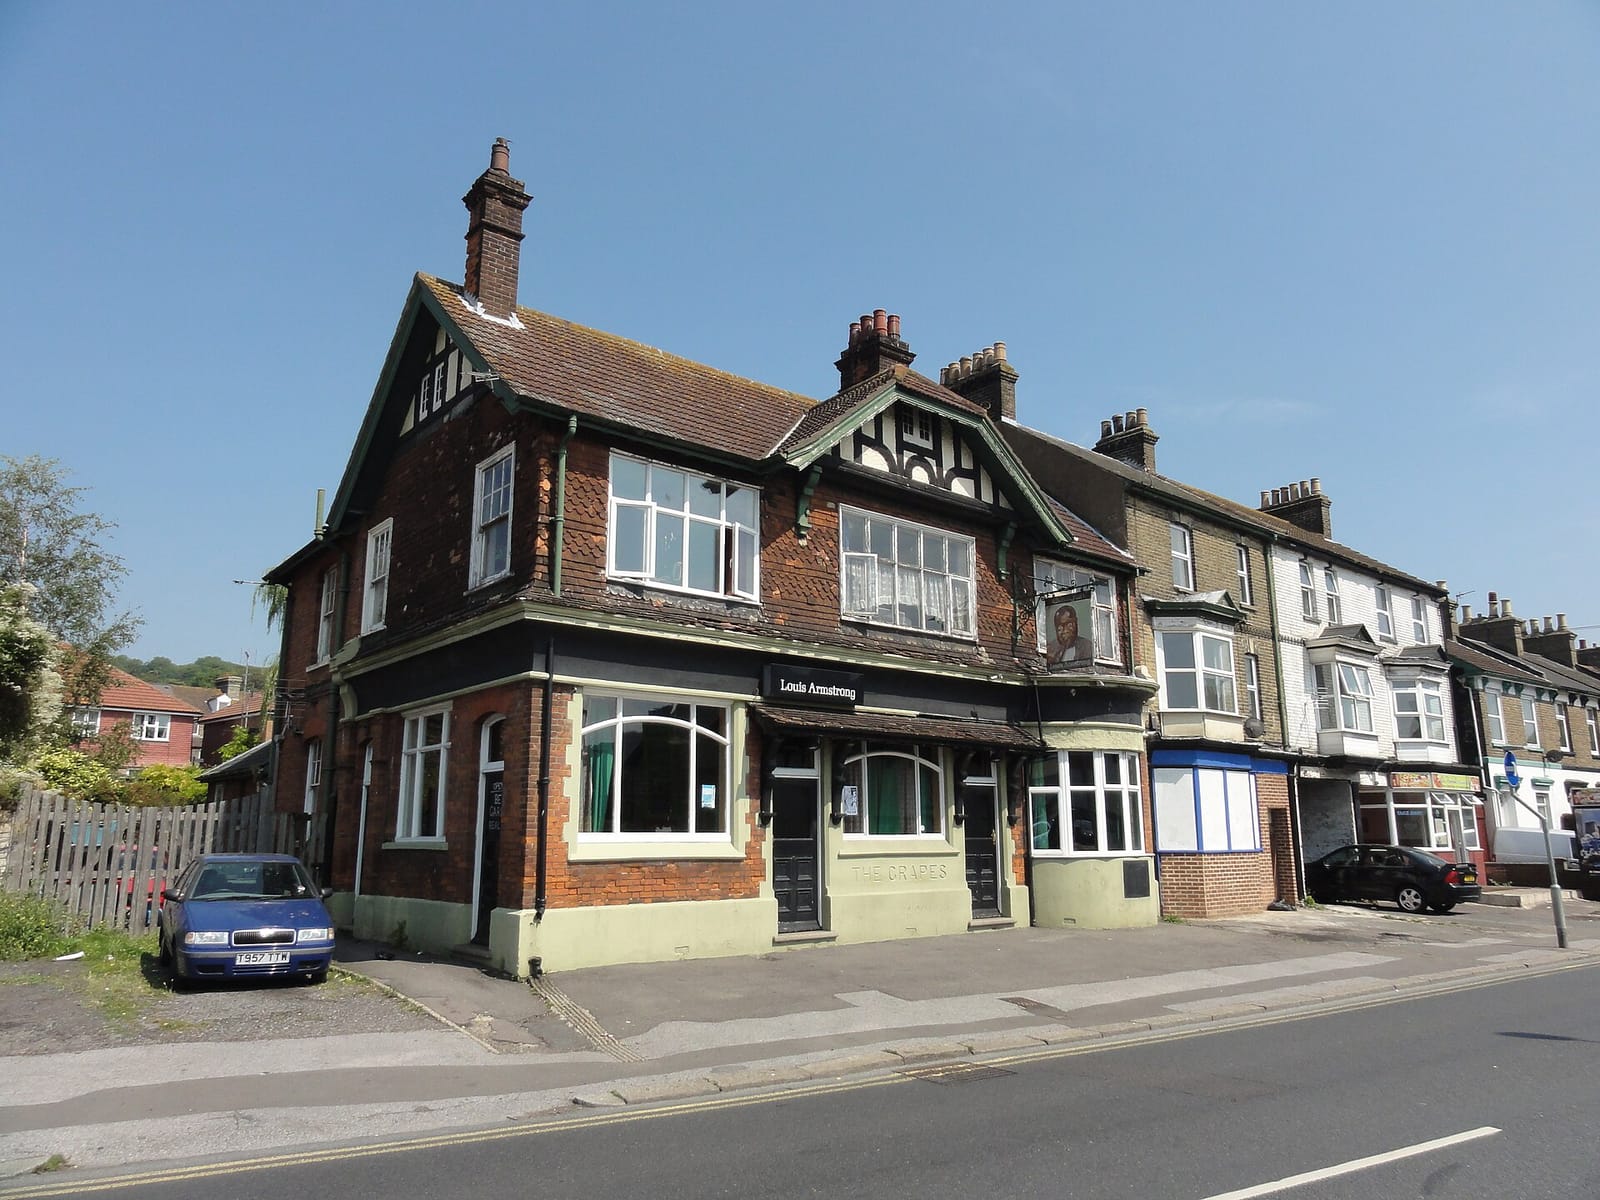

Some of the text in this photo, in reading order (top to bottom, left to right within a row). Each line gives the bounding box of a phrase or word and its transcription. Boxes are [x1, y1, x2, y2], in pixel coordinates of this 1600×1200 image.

[780, 679, 855, 700] Louis Armstrong
[851, 864, 947, 882] THE GRAPES
[238, 953, 265, 963] T957
